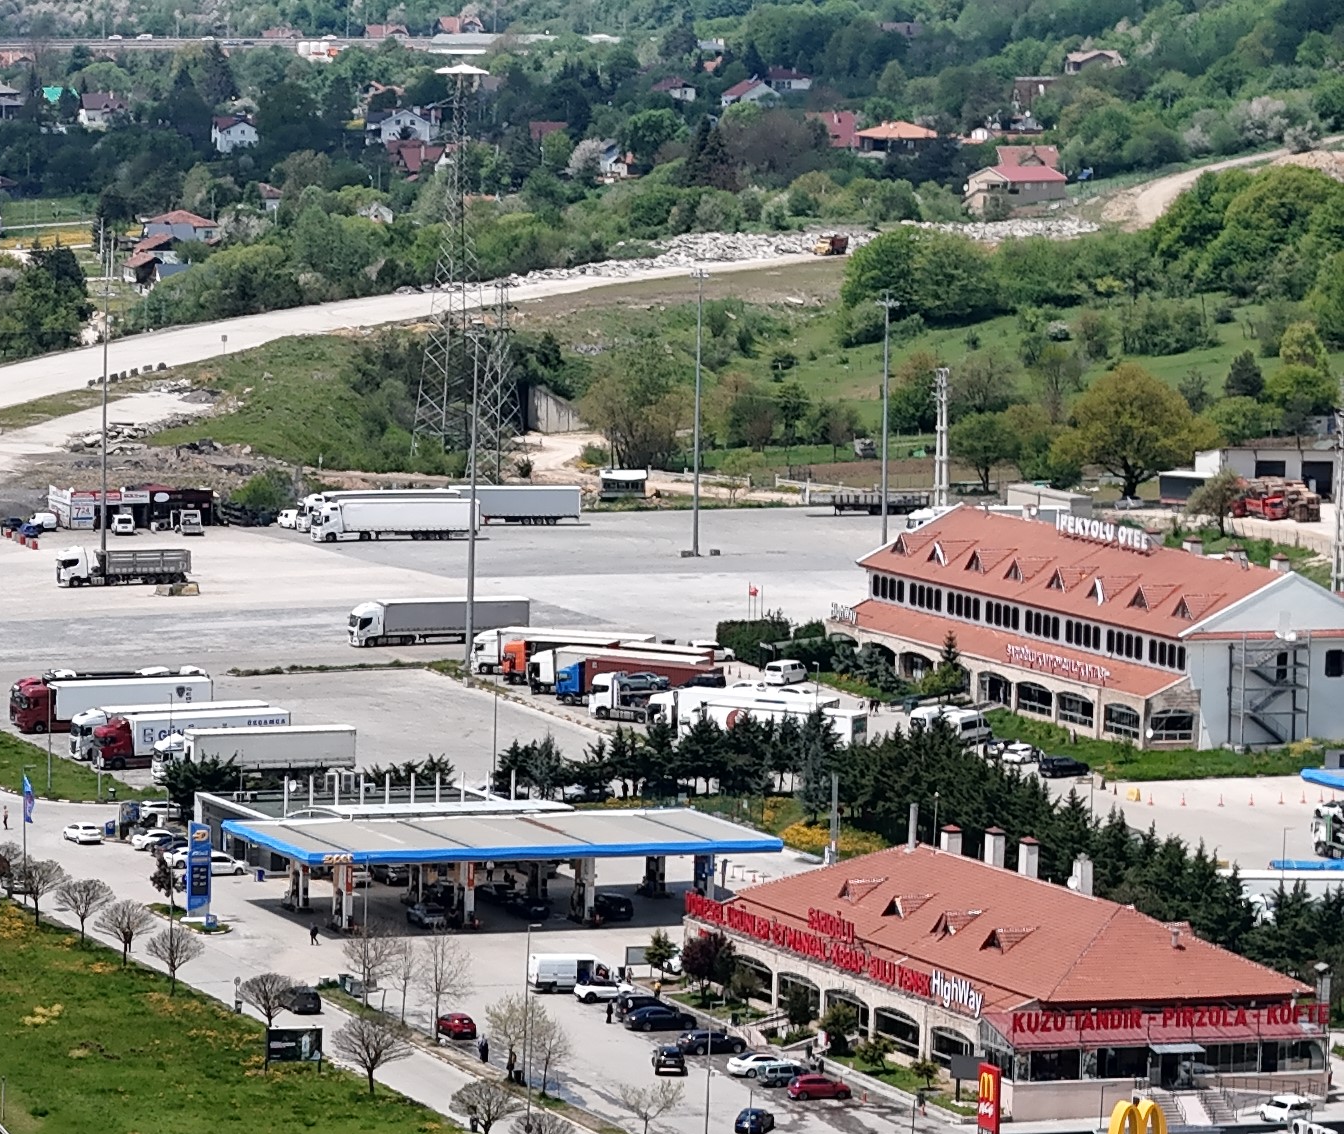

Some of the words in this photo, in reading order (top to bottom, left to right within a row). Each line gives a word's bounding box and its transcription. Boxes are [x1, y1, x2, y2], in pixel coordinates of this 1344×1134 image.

[1056, 508, 1114, 541] İPEKYOLU
[932, 969, 983, 1018] HighWay
[1012, 1010, 1065, 1033] KUZU
[1072, 1008, 1143, 1031] TANDIR
[1162, 1004, 1248, 1028] PİRZOLA
